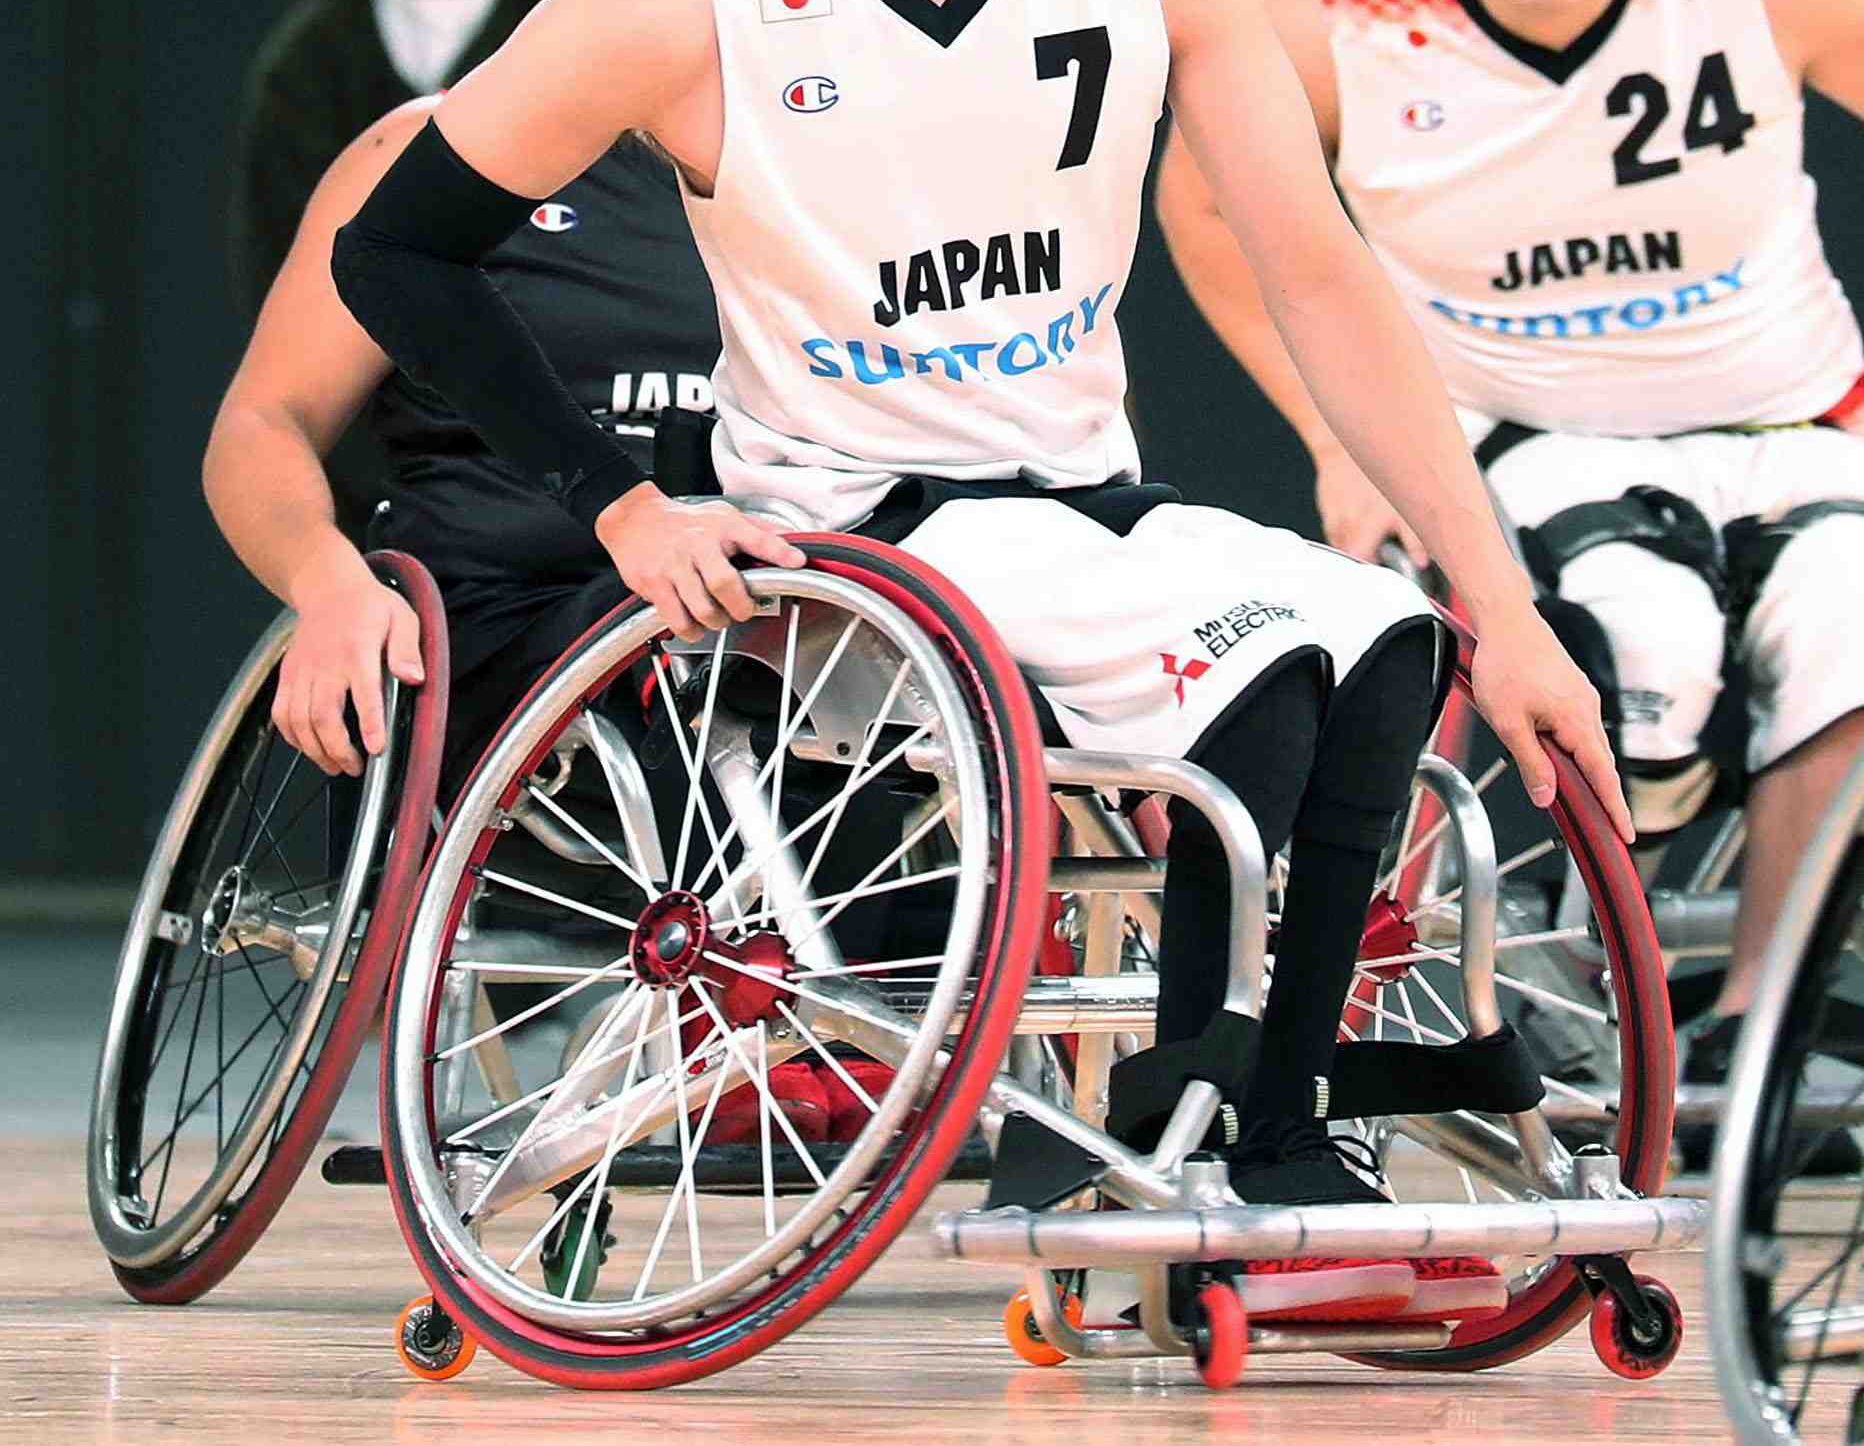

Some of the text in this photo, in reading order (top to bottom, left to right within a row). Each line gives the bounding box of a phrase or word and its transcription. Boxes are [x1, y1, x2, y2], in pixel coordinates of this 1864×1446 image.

[1033, 25, 1111, 171] 7
[1606, 51, 1755, 186] 24
[873, 228, 1061, 327] JAPAN
[1492, 231, 1681, 291] JAPAN
